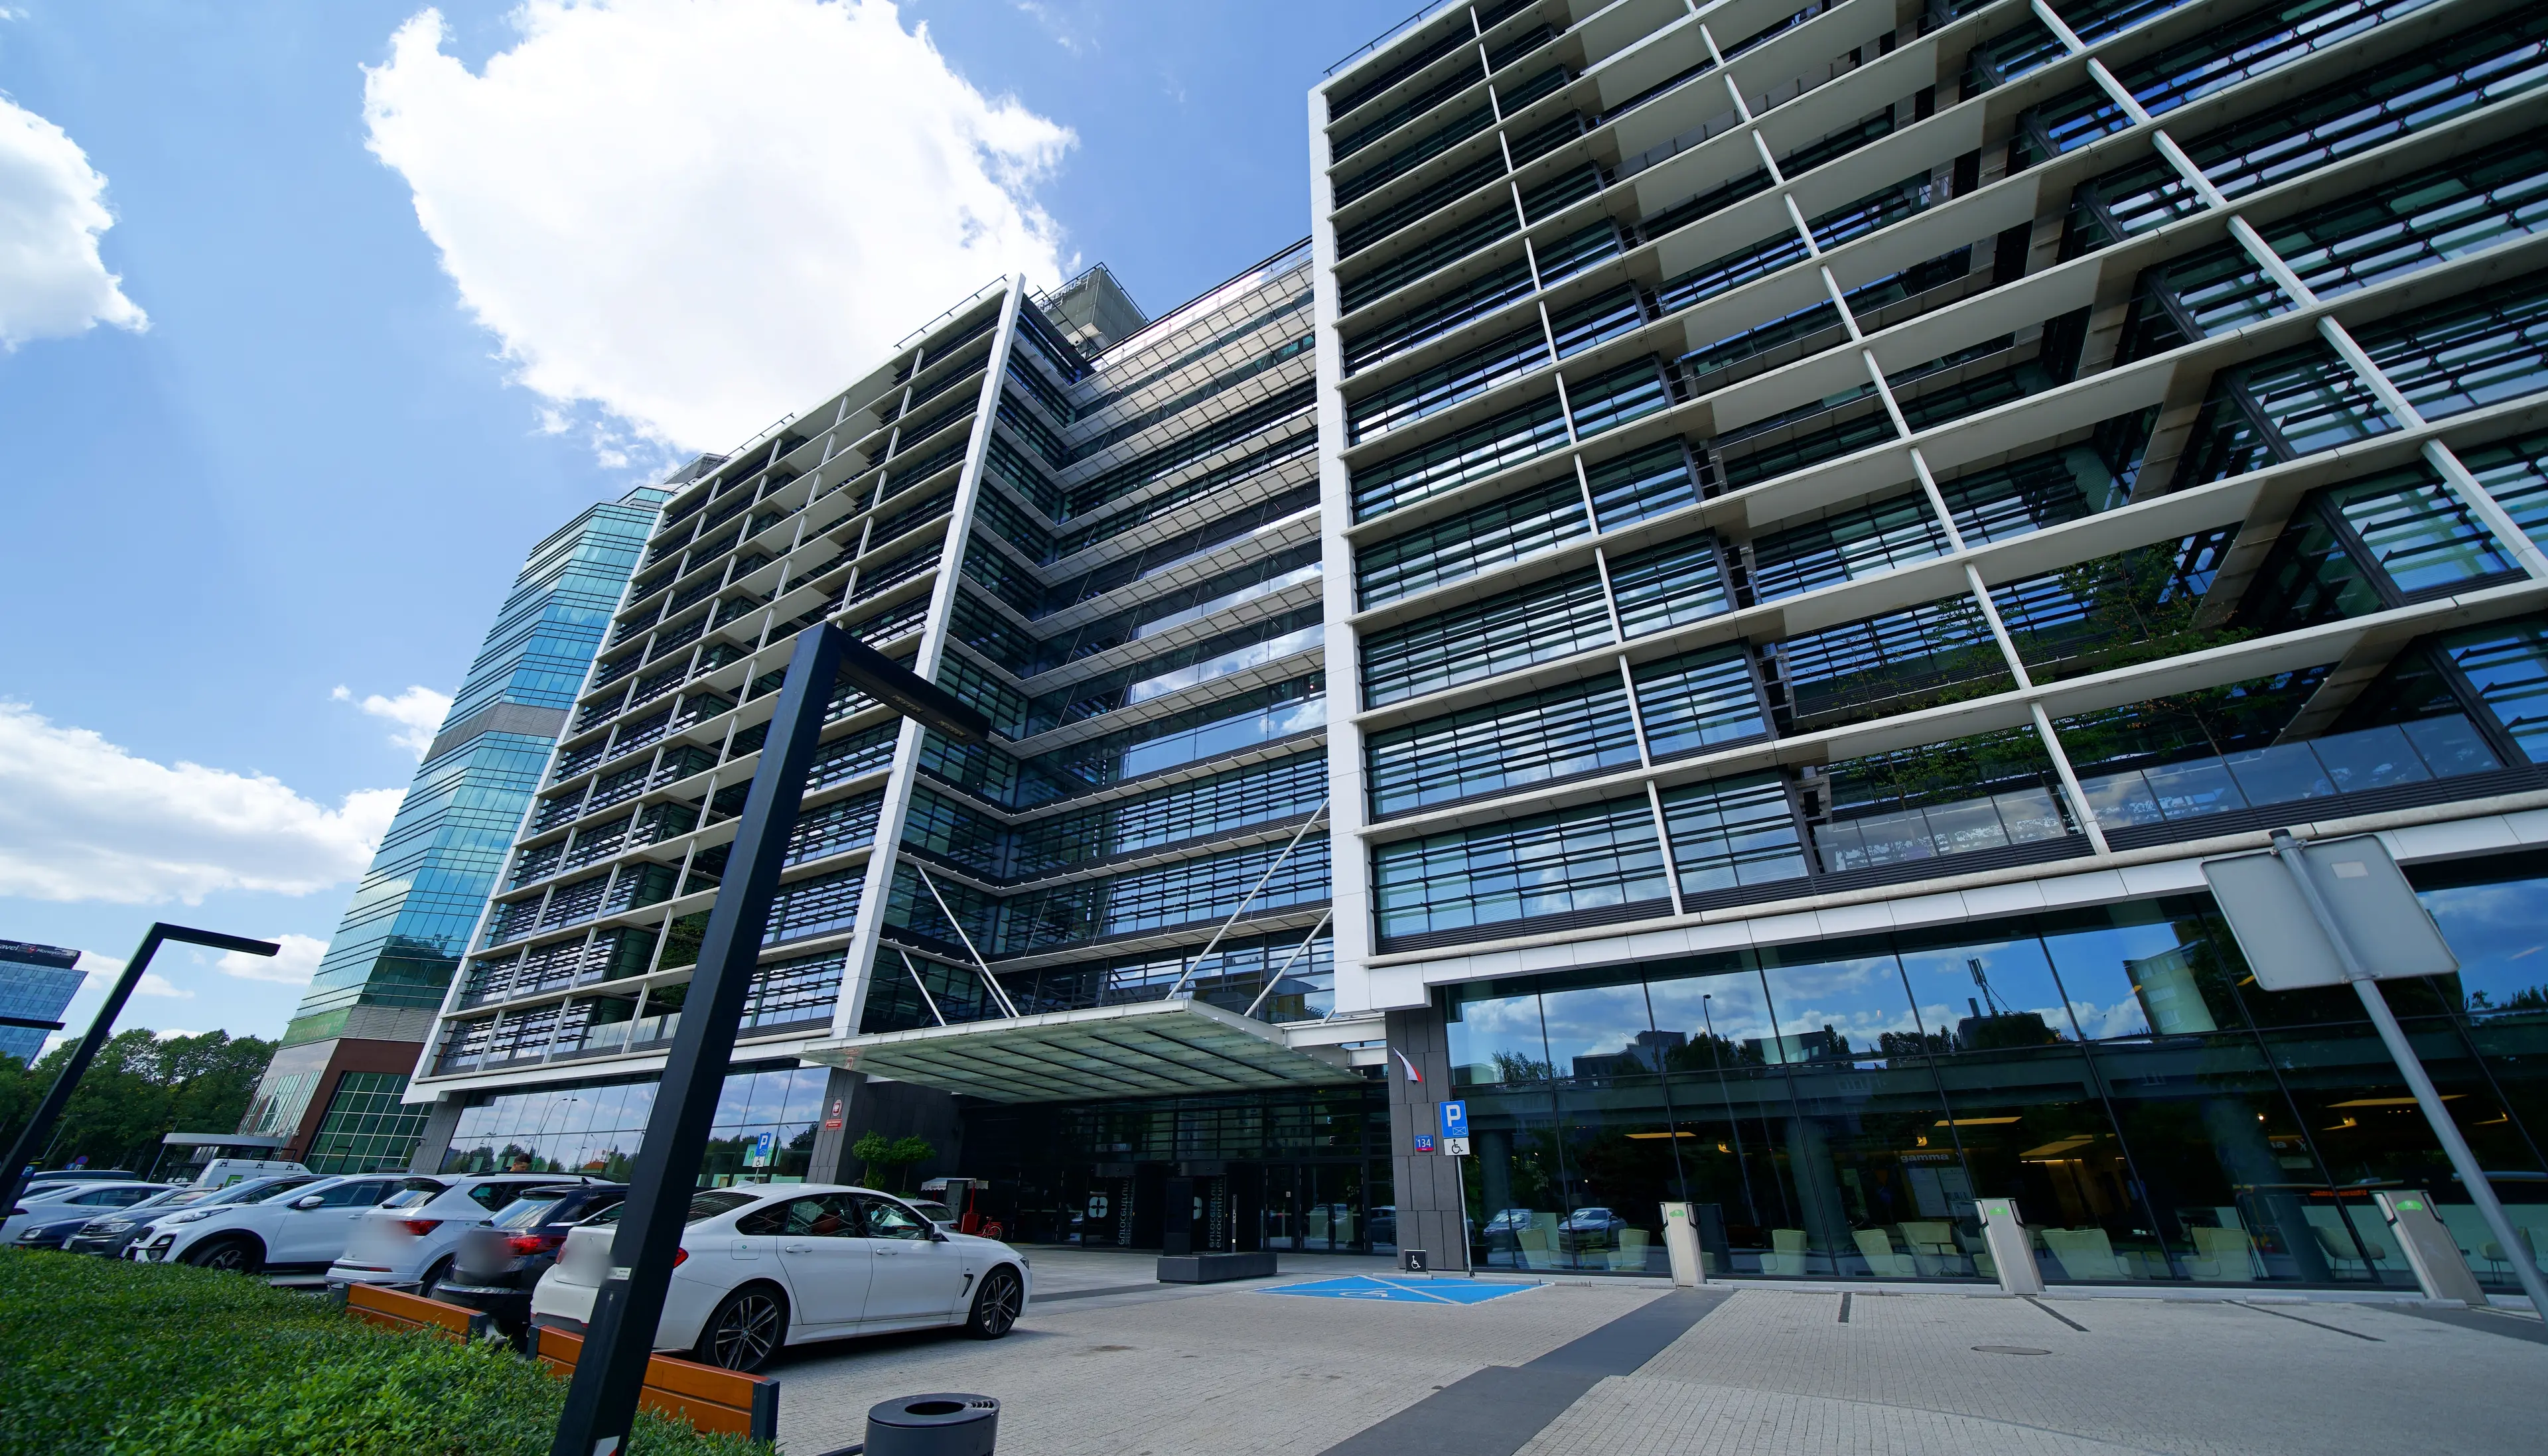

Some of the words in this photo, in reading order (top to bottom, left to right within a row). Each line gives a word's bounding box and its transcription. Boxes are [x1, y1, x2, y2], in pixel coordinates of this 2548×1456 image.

[1037, 279, 1082, 309] RESENIUS
[1446, 1104, 1461, 1127] P
[759, 1135, 768, 1150] P
[1417, 1138, 1431, 1148] 134
[1900, 1154, 1950, 1163] gamma
[22, 1166, 33, 1175] P
